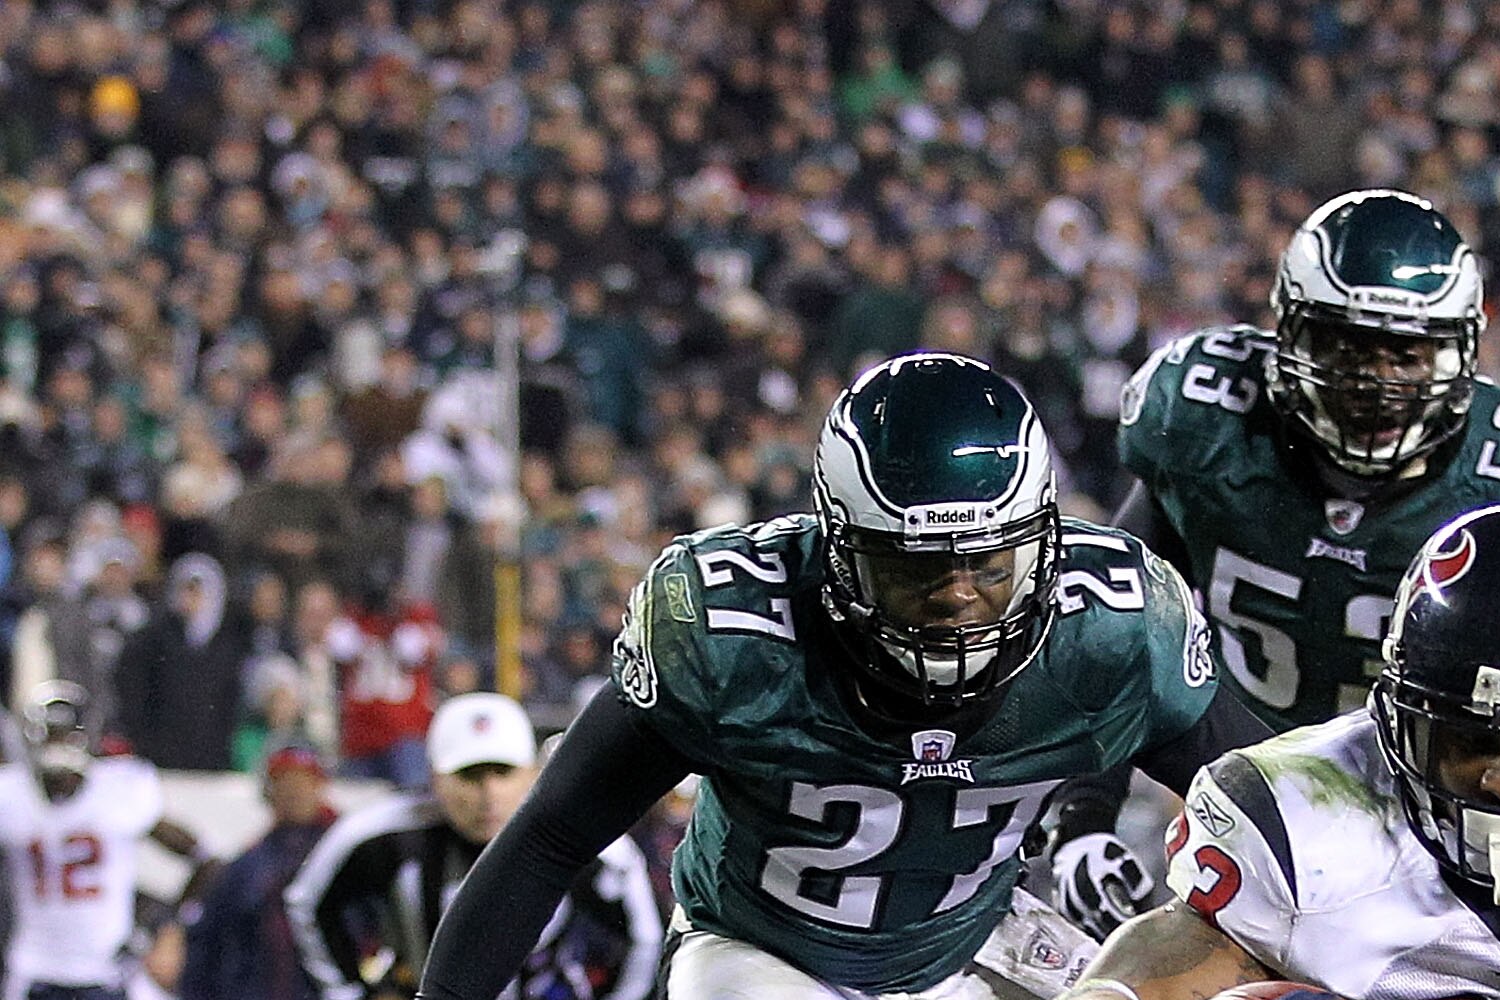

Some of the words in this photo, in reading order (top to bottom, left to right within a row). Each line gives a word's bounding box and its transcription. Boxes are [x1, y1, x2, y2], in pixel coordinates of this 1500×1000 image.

[926, 509, 976, 524] Riddell
[695, 549, 797, 642] 27
[900, 759, 975, 786] EAGLES
[27, 833, 101, 899] 12
[760, 778, 1067, 929] 27
